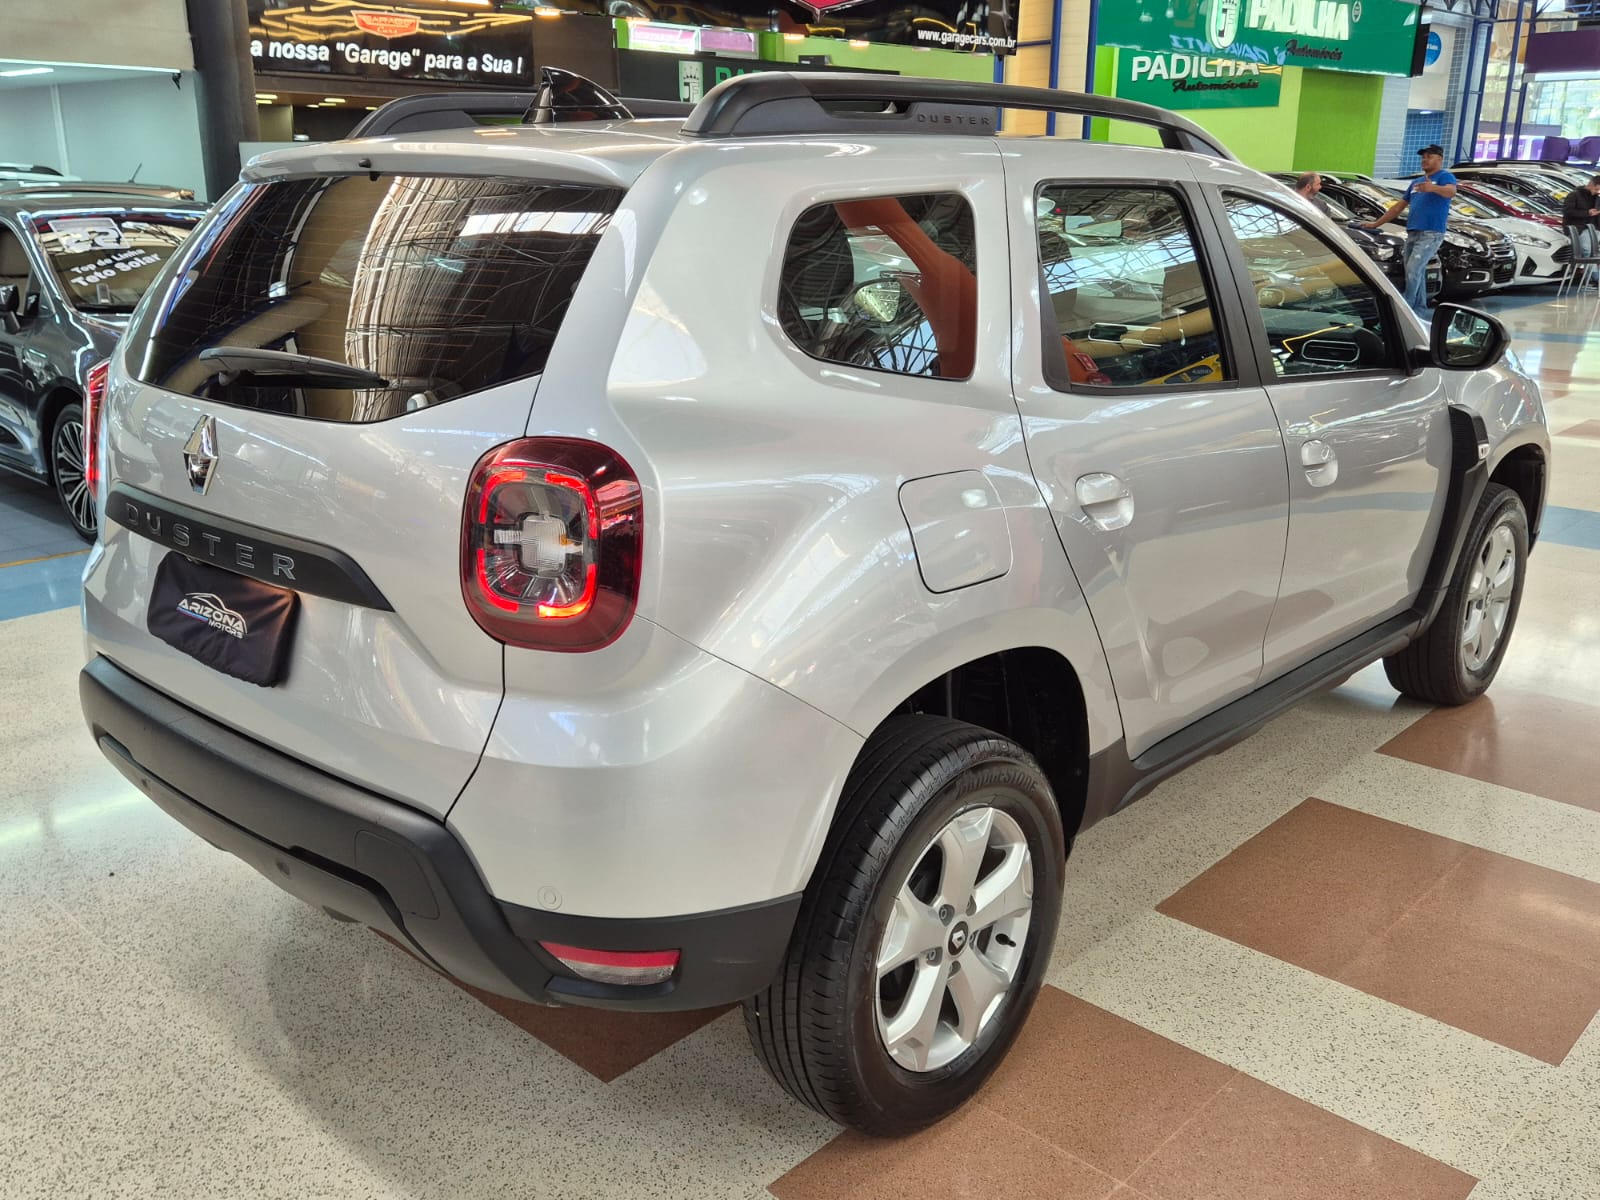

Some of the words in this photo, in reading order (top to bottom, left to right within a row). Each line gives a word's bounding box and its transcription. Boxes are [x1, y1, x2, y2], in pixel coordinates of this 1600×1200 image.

[1246, 0, 1350, 41] PADILHA
[917, 29, 1017, 49] www.garagecars.com.br
[249, 39, 263, 57] a
[268, 41, 330, 61] nossa
[335, 42, 420, 71] "Garage"
[424, 53, 463, 73] para
[466, 56, 478, 71] a
[481, 53, 513, 74] Sua
[1131, 53, 1260, 82] PADILHA
[917, 113, 991, 126] DUSTER
[70, 262, 97, 274] Top
[70, 268, 117, 287] Teto
[114, 252, 161, 272] Solar
[125, 502, 297, 581] DUSTER
[177, 598, 245, 633] ARIZONA
[207, 618, 244, 640] MOTORS
